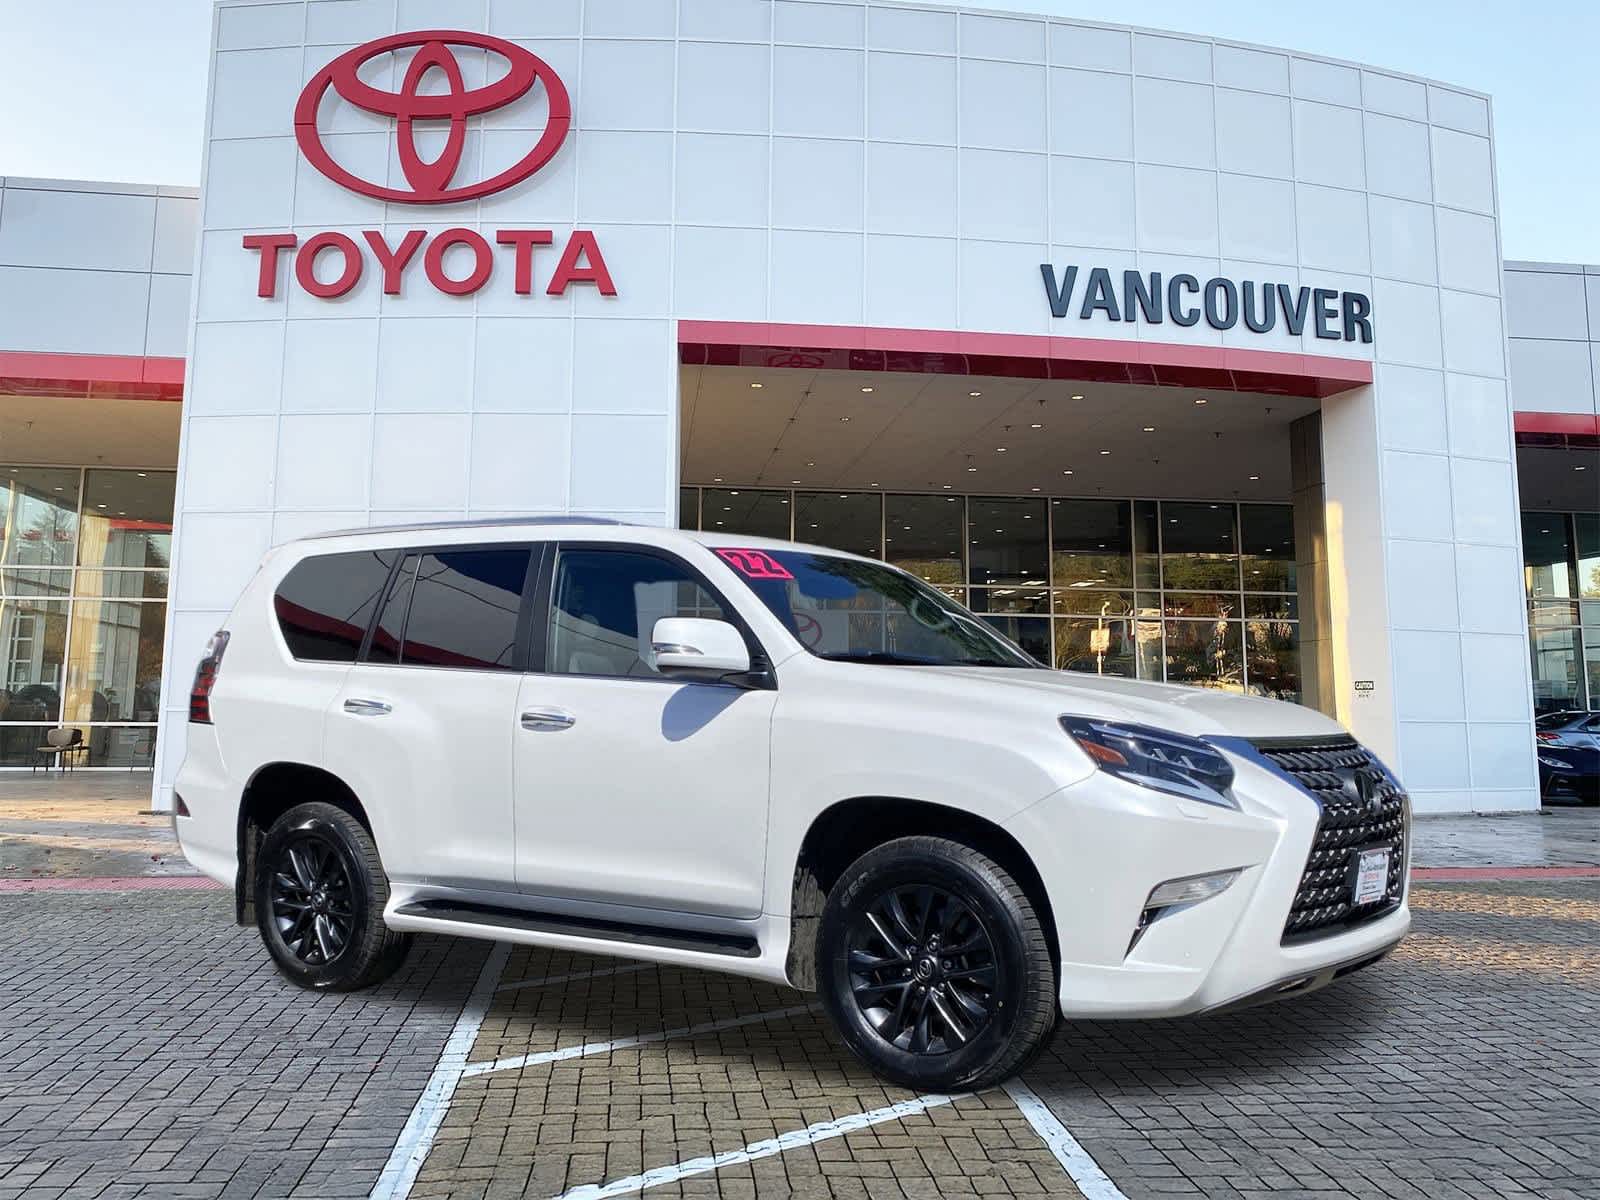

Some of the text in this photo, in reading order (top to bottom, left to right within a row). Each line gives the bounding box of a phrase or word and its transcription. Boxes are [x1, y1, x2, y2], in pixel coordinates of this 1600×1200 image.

[242, 228, 618, 298] TOYOTA
[1040, 263, 1373, 344] VANCOUVER
[723, 551, 785, 575] 22
